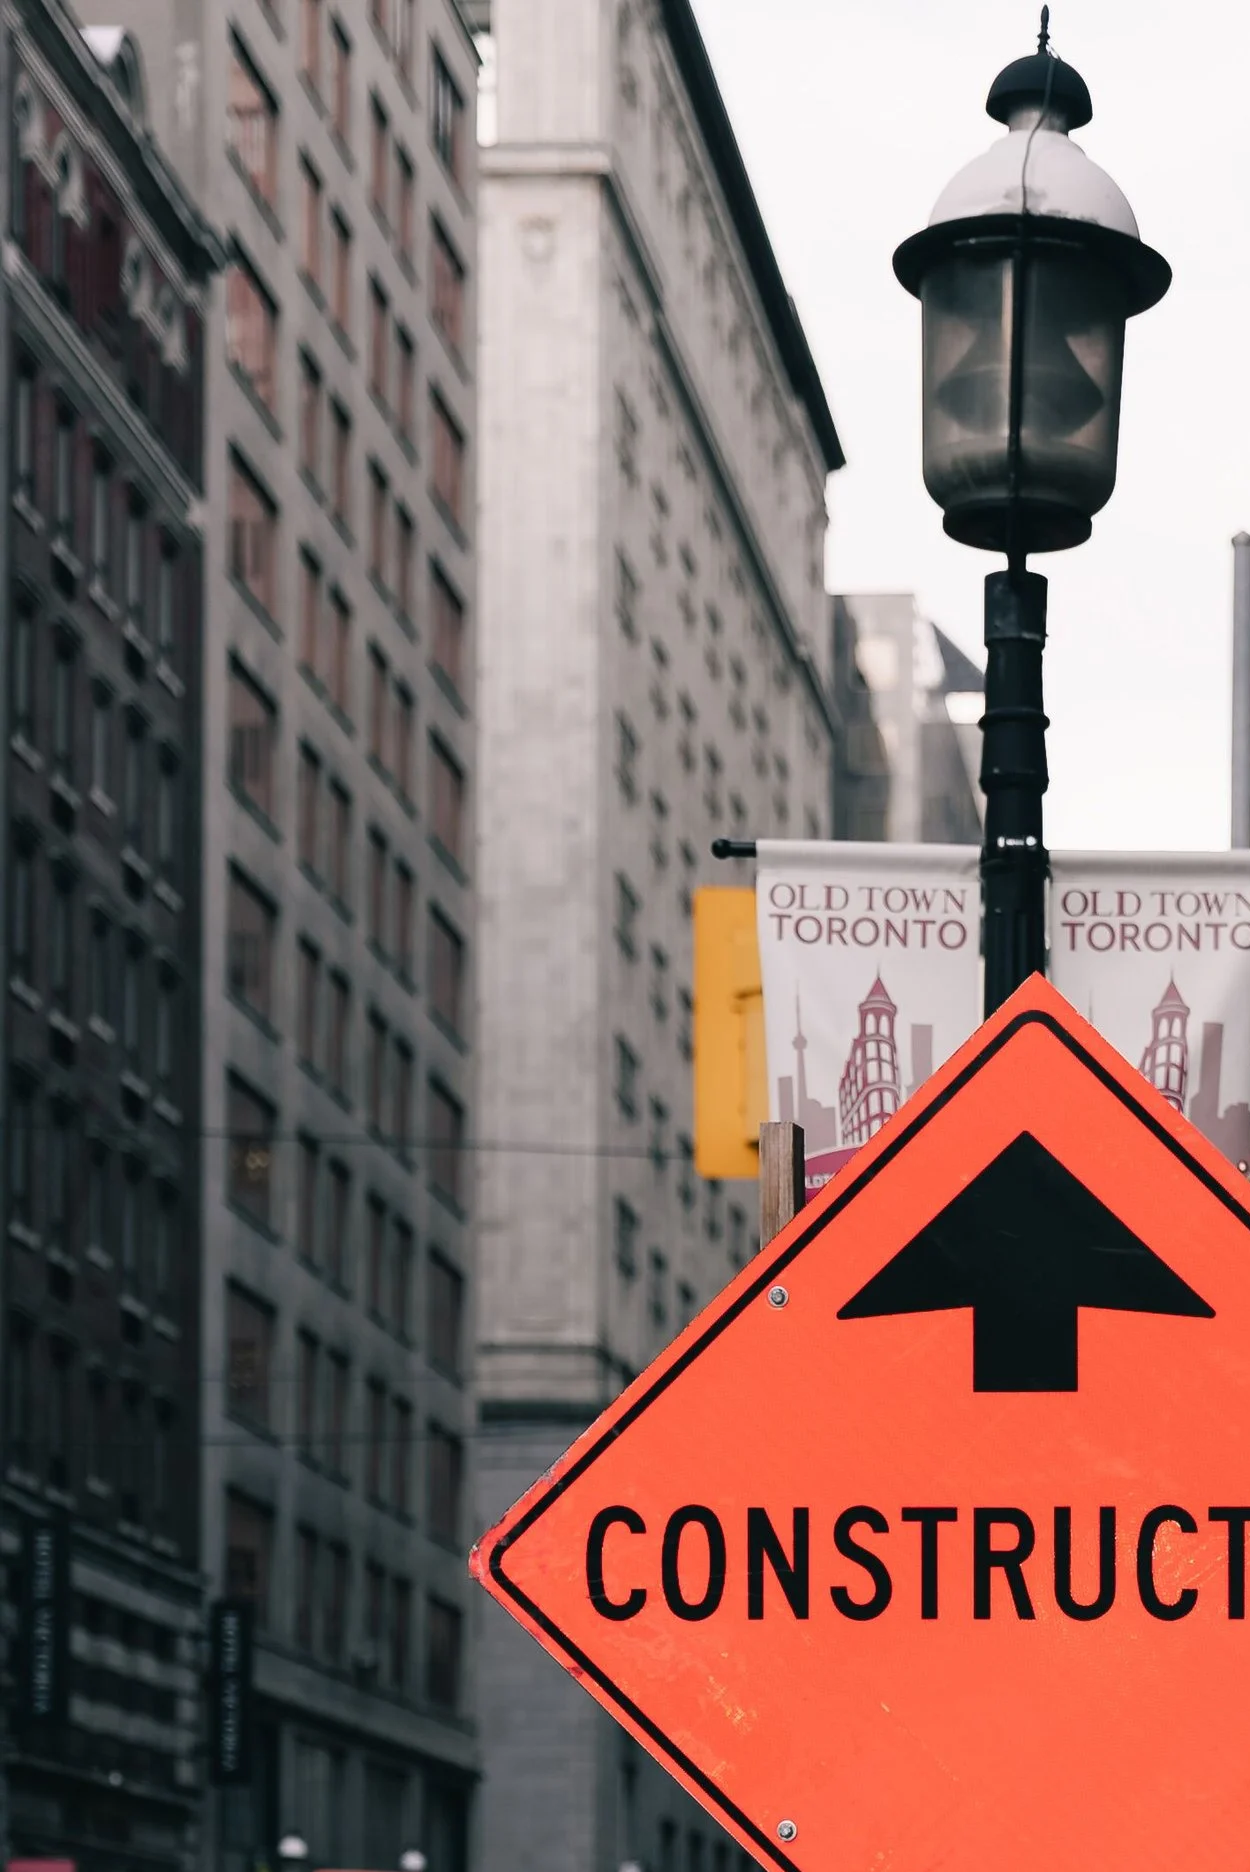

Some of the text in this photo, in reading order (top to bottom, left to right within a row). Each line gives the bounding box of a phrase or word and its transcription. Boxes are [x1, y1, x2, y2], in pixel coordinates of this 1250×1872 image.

[769, 883, 967, 915] OLD TOWN
[1062, 889, 1141, 918] OLD
[768, 913, 968, 951] TORONTO
